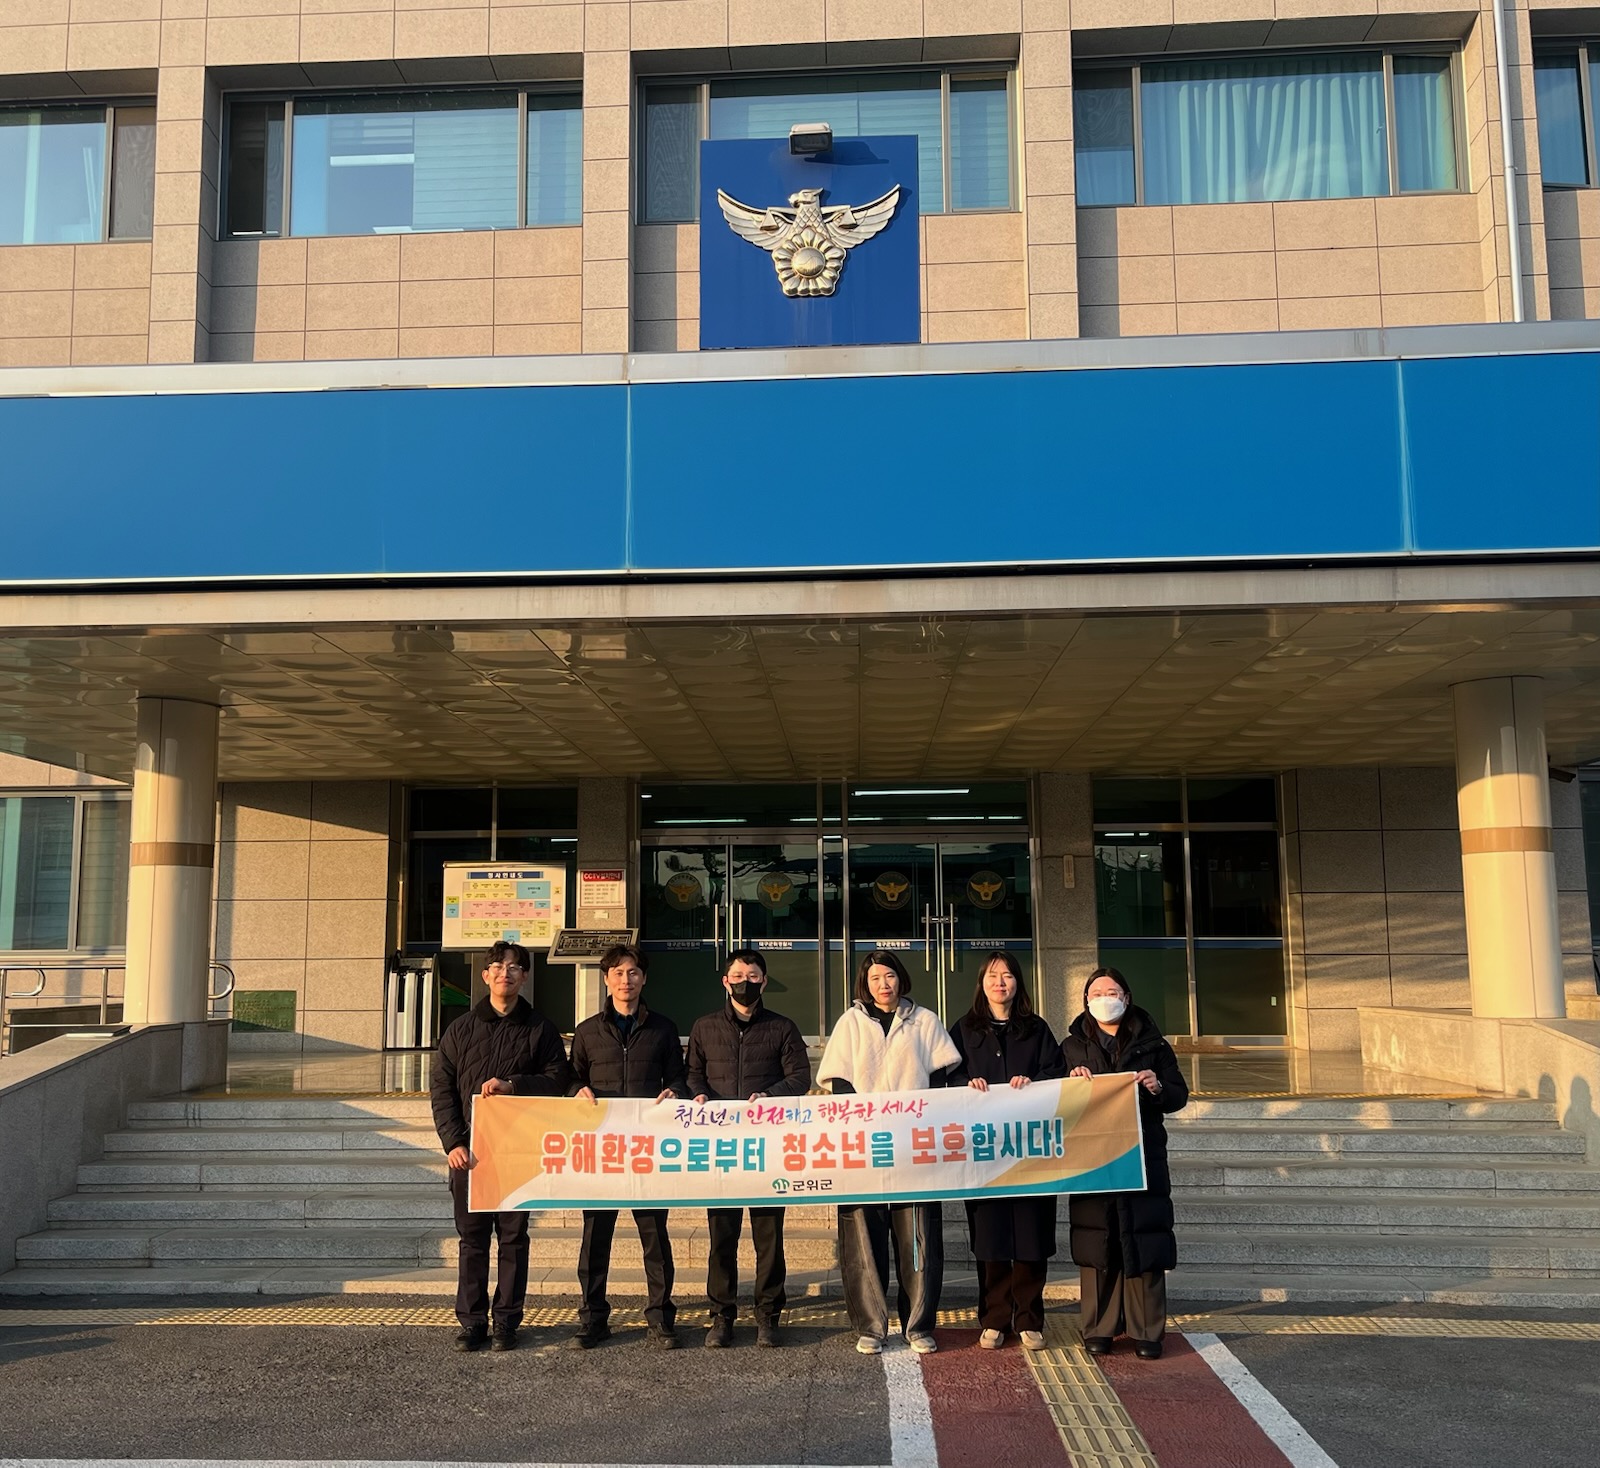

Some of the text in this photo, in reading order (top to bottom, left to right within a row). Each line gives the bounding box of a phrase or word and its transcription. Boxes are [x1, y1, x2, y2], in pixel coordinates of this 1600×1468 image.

[674, 1098, 928, 1128] 청소년이 안전하고 행복한 세상
[543, 1118, 1064, 1174] 유해환경으로부터 청소년을 보호합시다!
[792, 1179, 833, 1192] 군위군
